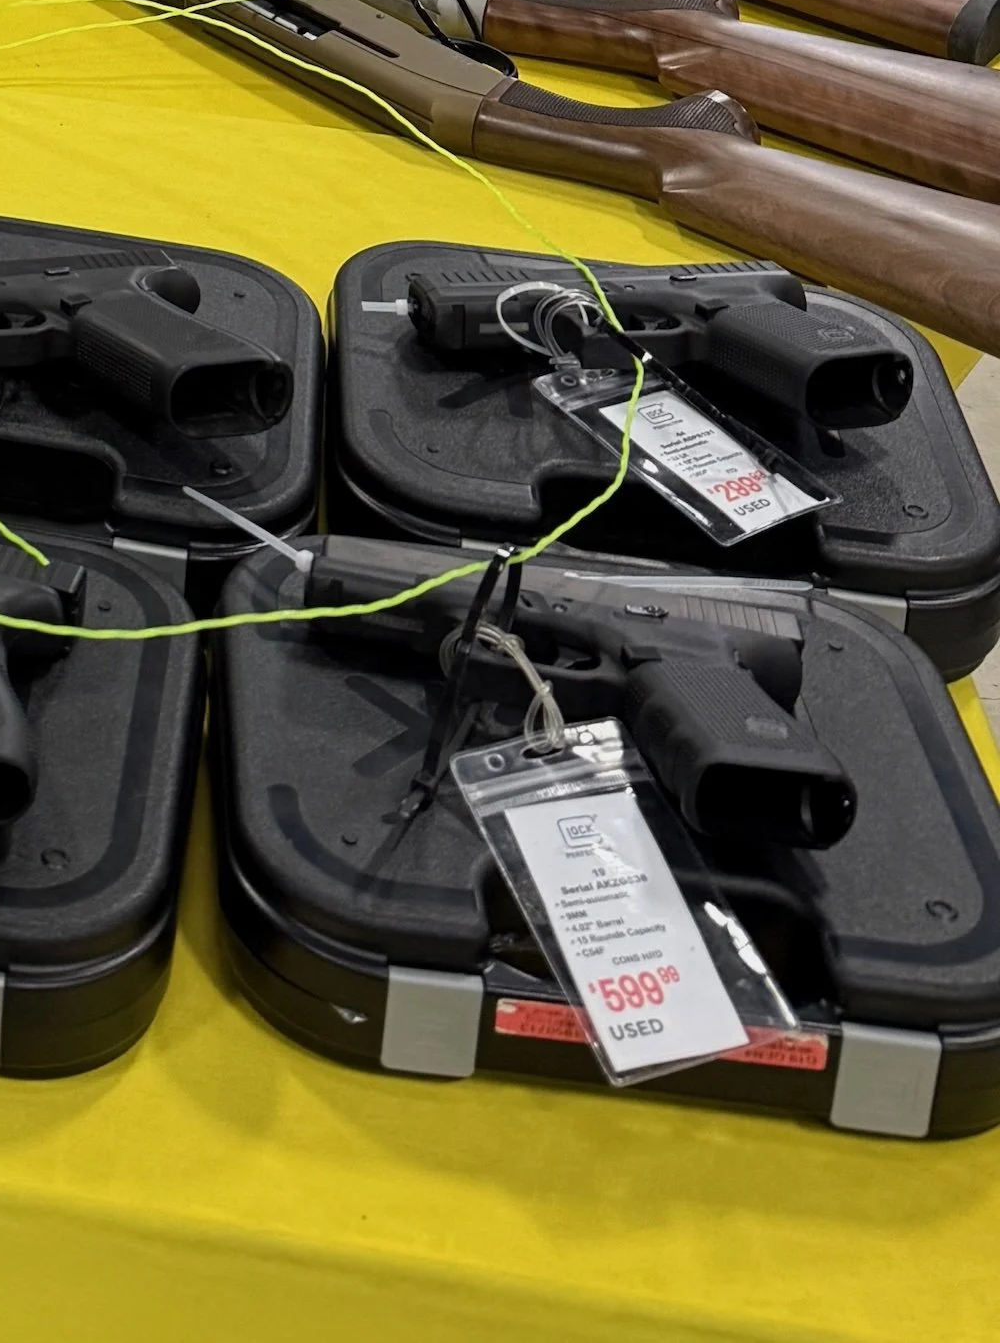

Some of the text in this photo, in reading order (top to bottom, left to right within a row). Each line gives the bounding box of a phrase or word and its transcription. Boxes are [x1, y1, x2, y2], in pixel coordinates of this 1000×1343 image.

[733, 498, 771, 516] USED
[626, 923, 666, 937] Capacity
[608, 1018, 664, 1041] USED
